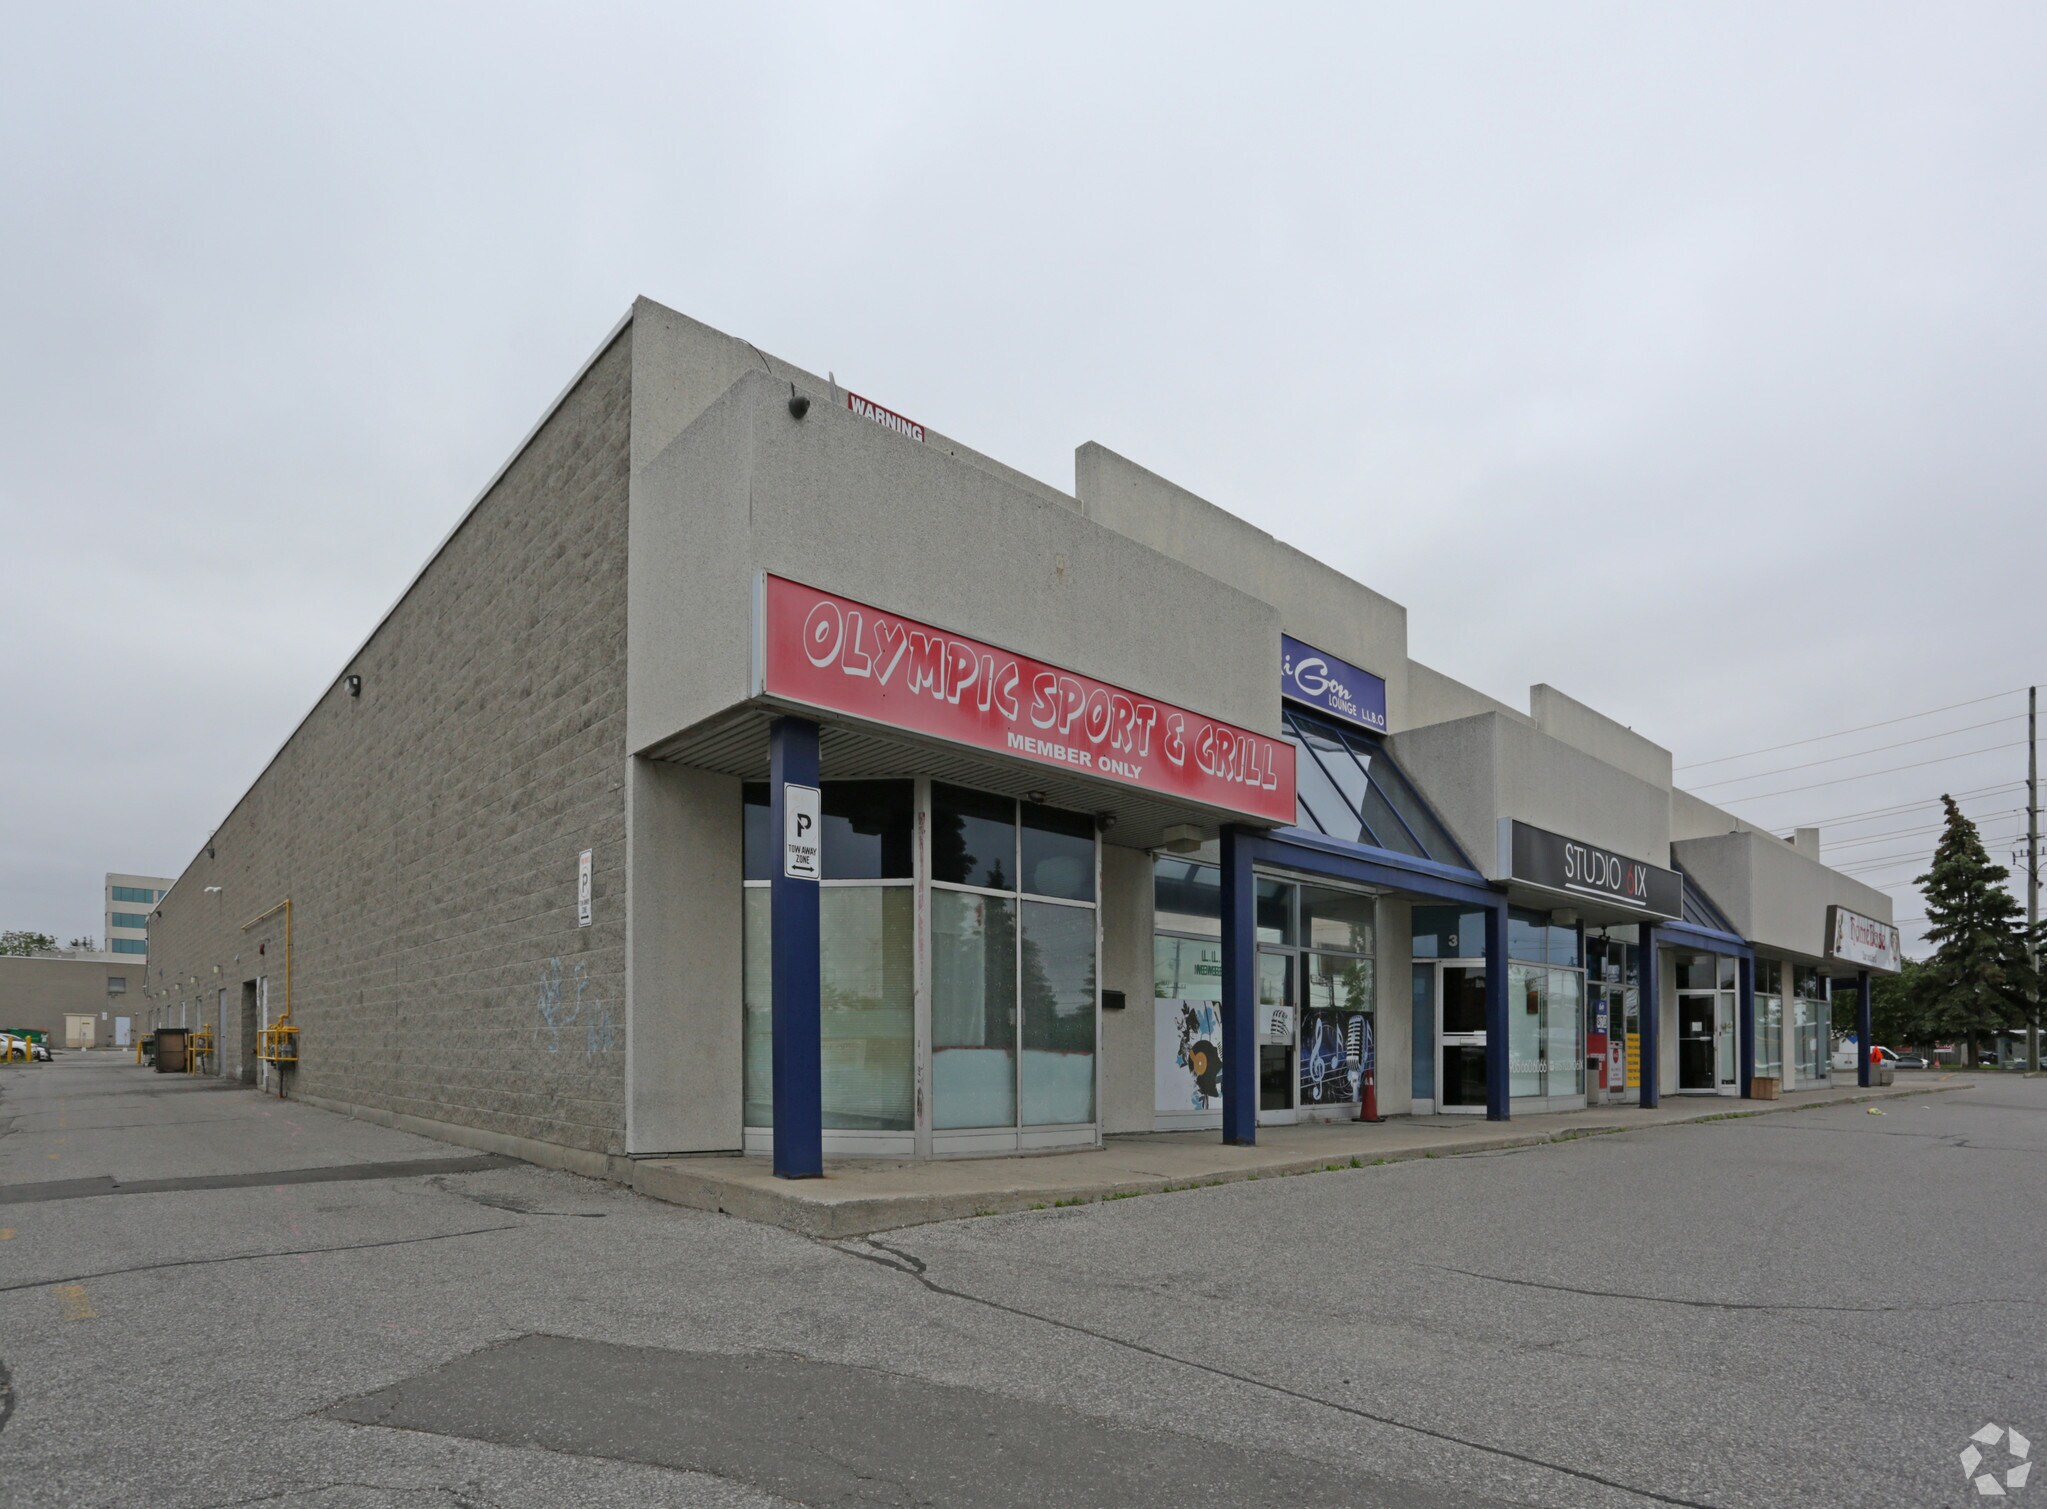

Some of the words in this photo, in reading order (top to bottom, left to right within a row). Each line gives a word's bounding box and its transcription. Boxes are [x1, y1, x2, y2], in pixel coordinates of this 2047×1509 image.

[850, 395, 923, 442] WARNING
[803, 601, 1019, 721] OLYMPIC
[1031, 672, 1156, 757] SPORT
[1164, 713, 1185, 766] &
[1194, 723, 1277, 790] GRILL
[1281, 654, 1352, 700] iGon
[1328, 694, 1357, 716] LOUNGE
[1007, 732, 1092, 768] MEMBER
[1099, 753, 1142, 780] ONLY
[788, 844, 801, 853] TOW
[801, 846, 817, 856] AWAY
[796, 854, 809, 865] ZONE
[1565, 842, 1621, 890] STUDIO
[1626, 863, 1647, 898] 6IX
[1448, 934, 1458, 947] 3
